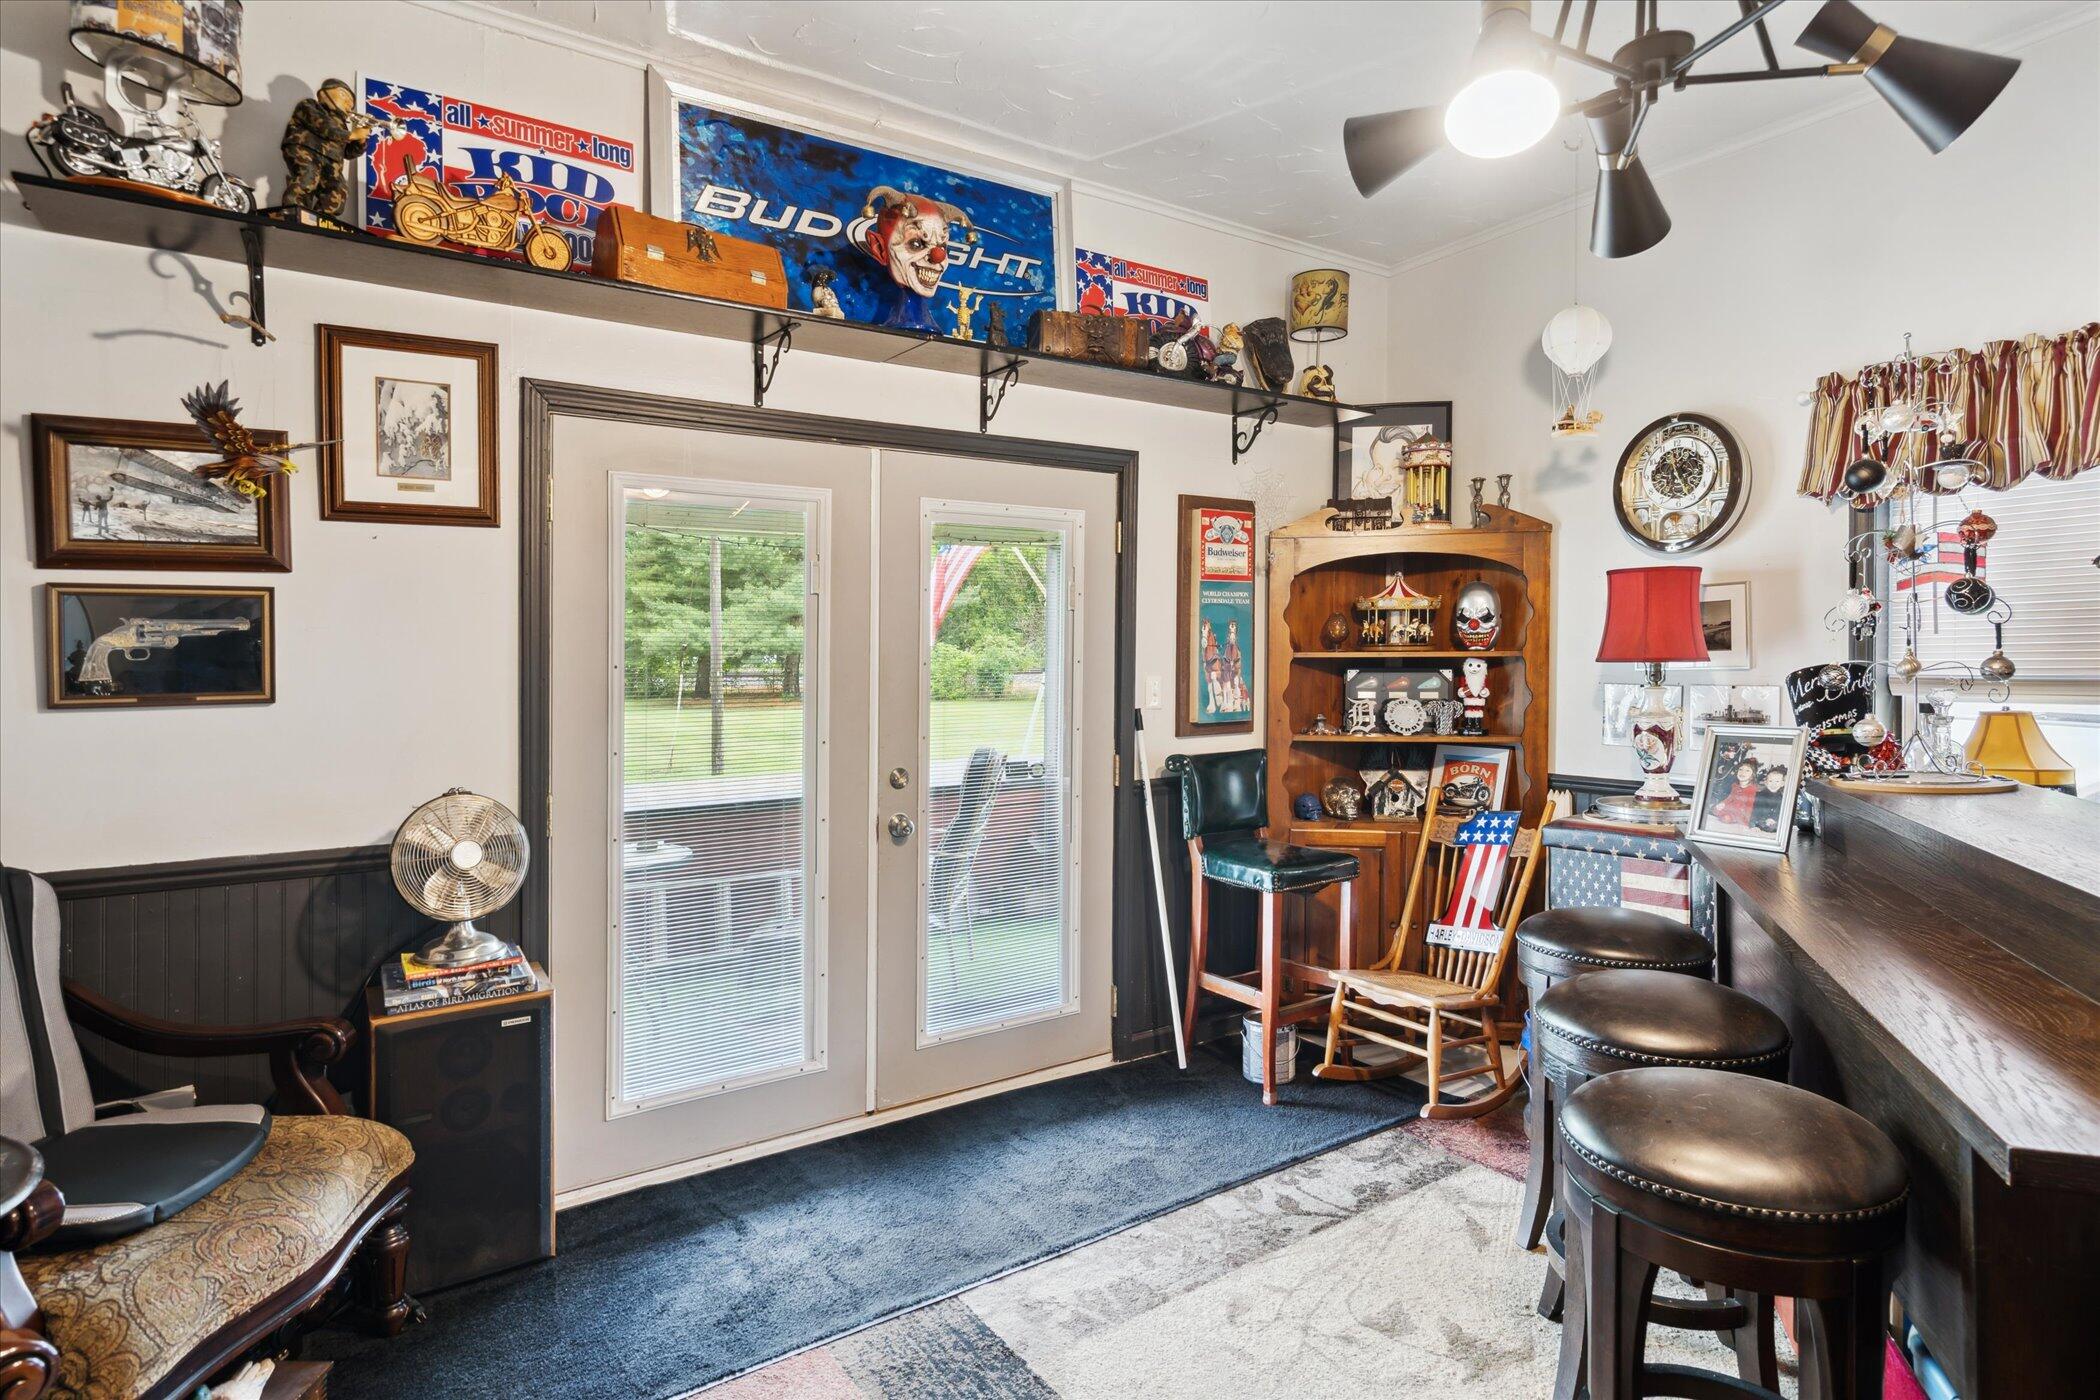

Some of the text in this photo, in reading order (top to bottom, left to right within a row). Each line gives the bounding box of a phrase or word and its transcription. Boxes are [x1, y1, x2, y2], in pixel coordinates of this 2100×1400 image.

[446, 104, 632, 168] all summer long
[458, 147, 615, 203] KID
[694, 184, 843, 238] BUD
[947, 242, 1043, 280] GHT
[1114, 262, 1207, 298] all summer long
[1207, 546, 1246, 558] Budweiser
[1202, 597, 1234, 605] CLYDESDALE
[1390, 718, 1421, 732] DETROIT
[1450, 764, 1491, 778] BORN
[412, 979, 436, 988] Birds
[397, 1001, 425, 1013] ATLAS
[427, 999, 439, 1008] OF
[442, 995, 465, 1006] BIRD
[467, 986, 520, 1003] MIGRATION
